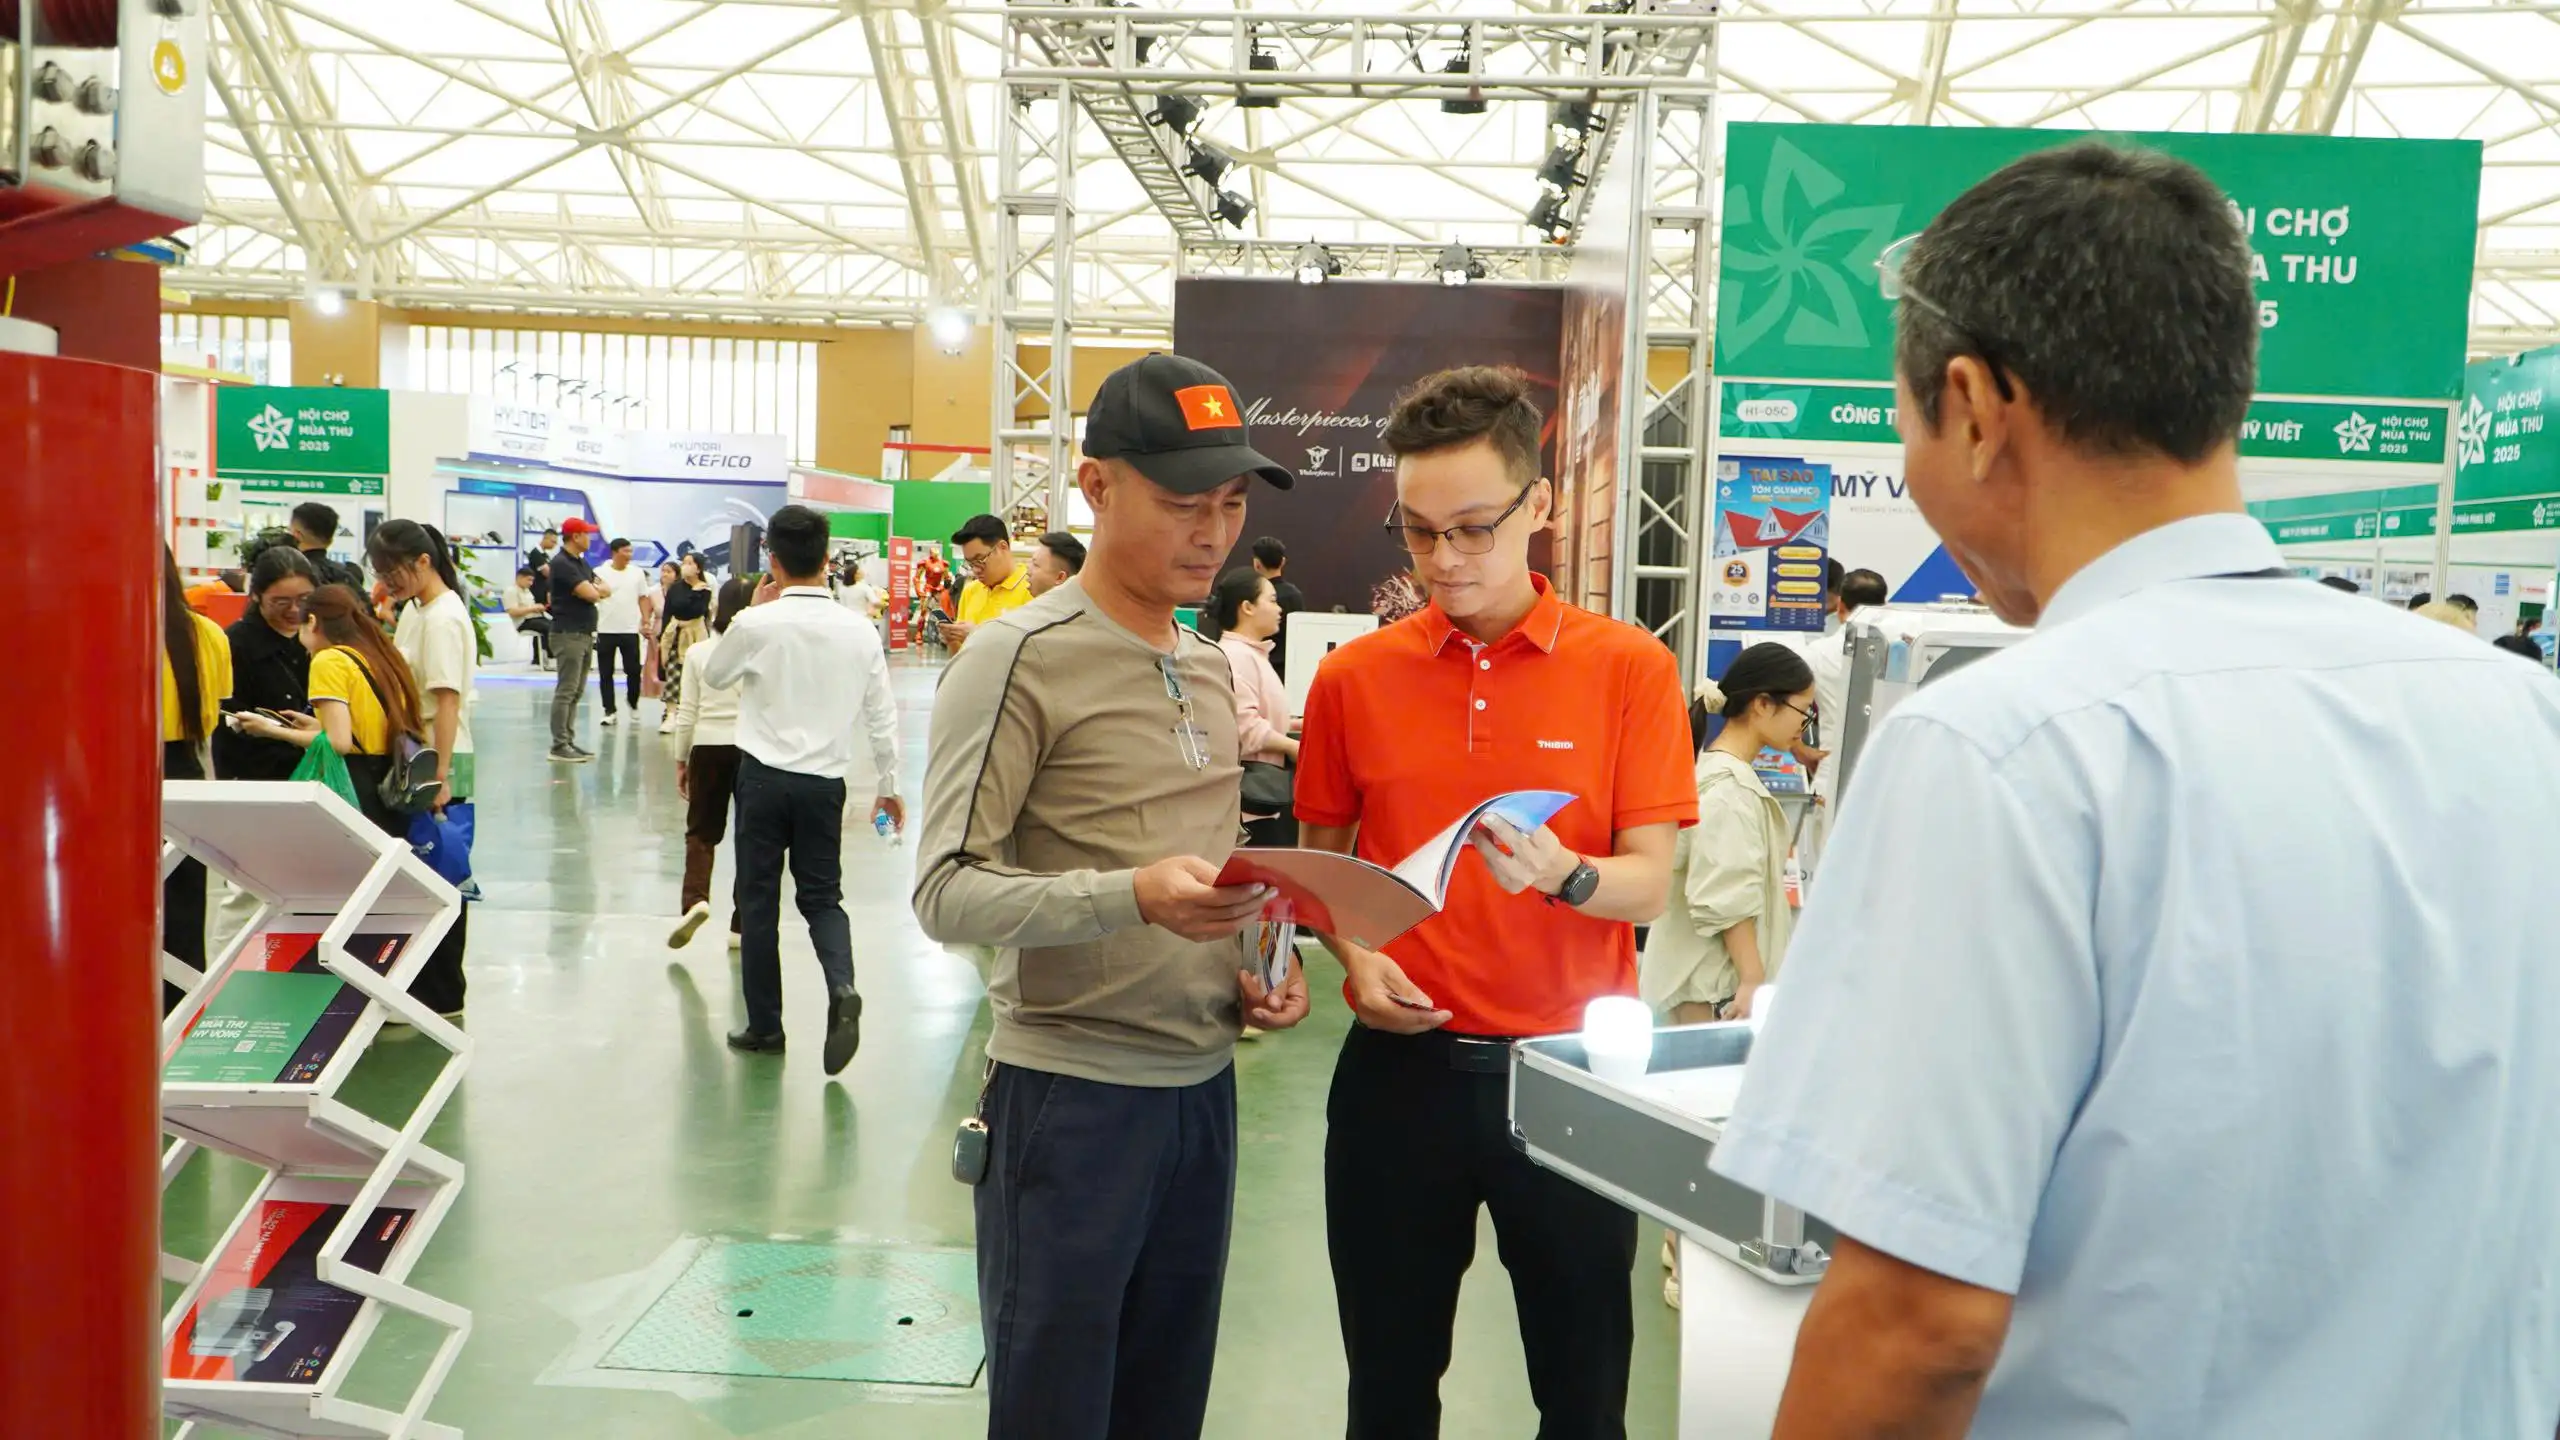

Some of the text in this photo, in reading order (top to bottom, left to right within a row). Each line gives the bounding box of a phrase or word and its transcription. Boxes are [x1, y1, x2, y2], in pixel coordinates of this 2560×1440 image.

[2266, 204, 2349, 246] CHỢ
[2281, 253, 2358, 284] THU
[1831, 402, 1881, 425] CÔNG
[2265, 419, 2304, 443] VIỆT
[2521, 414, 2544, 434] THU
[329, 426, 354, 438] THU
[2409, 430, 2431, 442] THU
[299, 440, 331, 452] 2025
[2379, 443, 2409, 455] 2025
[2492, 443, 2521, 464] 2025
[686, 453, 752, 469] KEFICO
[1780, 469, 1815, 484] SAO
[1832, 470, 1878, 498] MỸ
